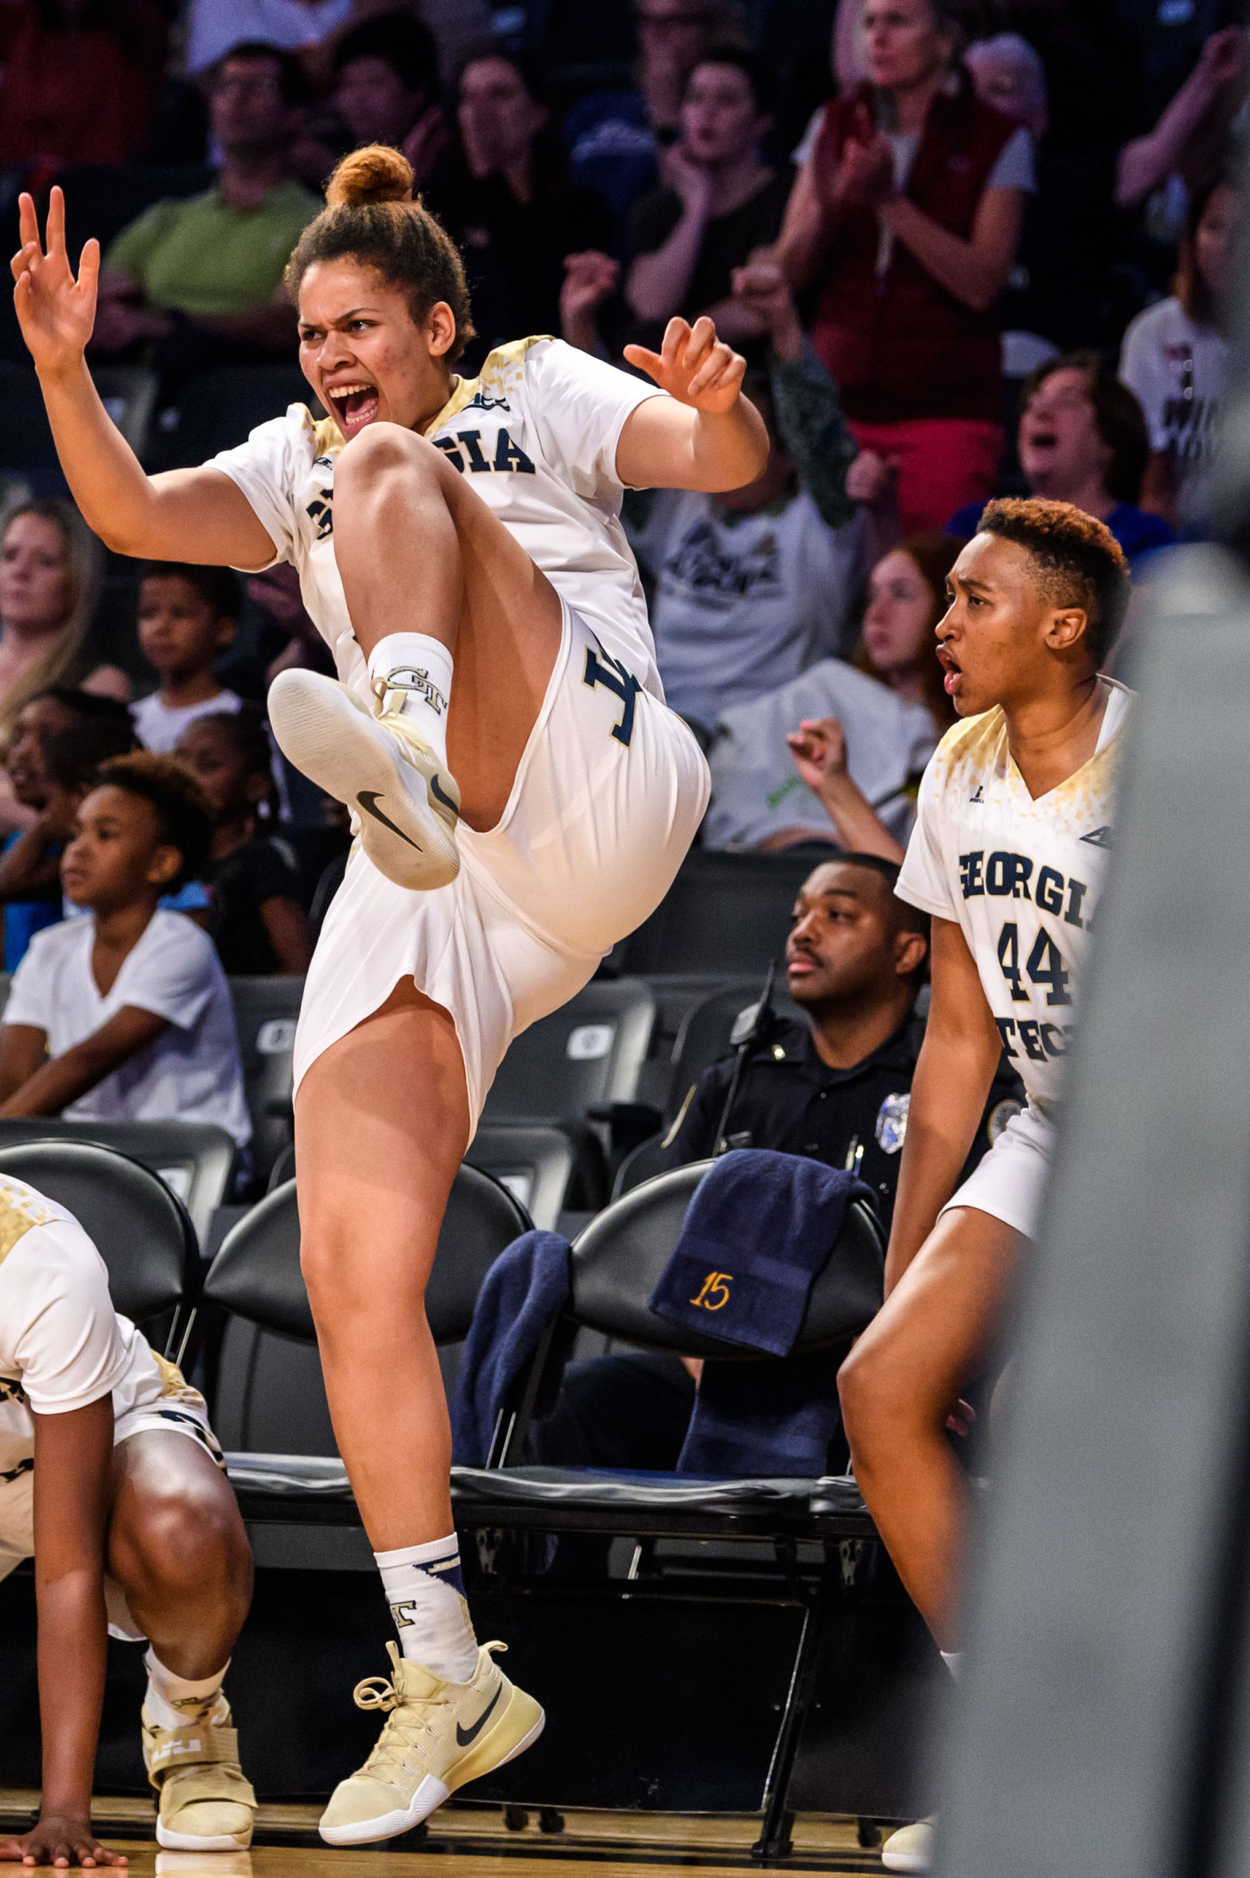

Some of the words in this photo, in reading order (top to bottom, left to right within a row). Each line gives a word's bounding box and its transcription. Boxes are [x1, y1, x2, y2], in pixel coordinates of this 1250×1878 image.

[959, 850, 1091, 932] GEORGI
[996, 919, 1072, 1006] 44
[689, 1271, 734, 1311] 15
